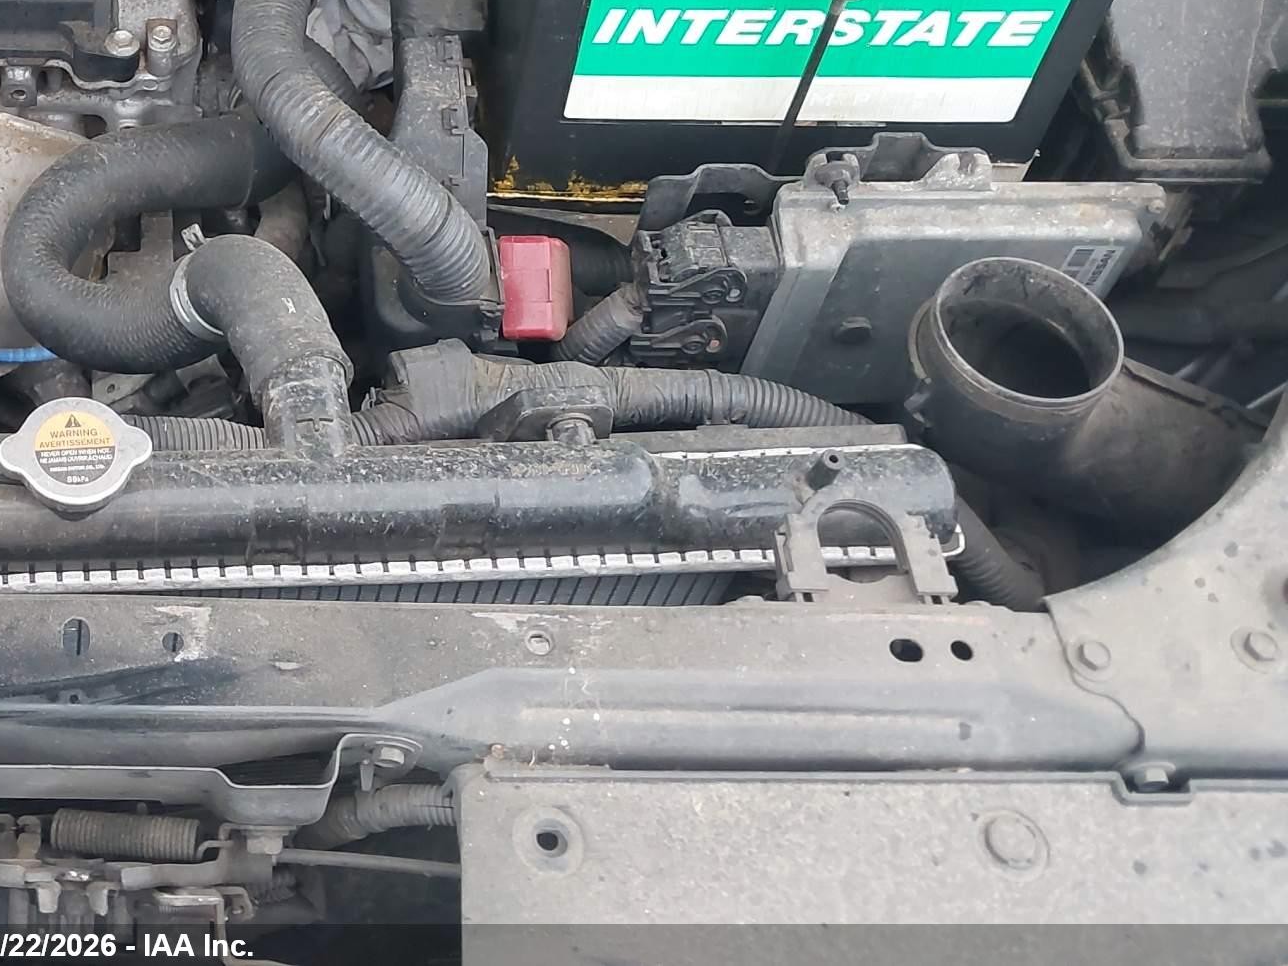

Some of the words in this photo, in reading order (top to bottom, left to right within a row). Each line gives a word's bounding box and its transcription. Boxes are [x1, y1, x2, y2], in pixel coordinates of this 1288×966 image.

[592, 8, 1055, 47] INTERSTATE
[50, 428, 98, 439] WARNING
[39, 437, 110, 449] AVERTISSEMENT
